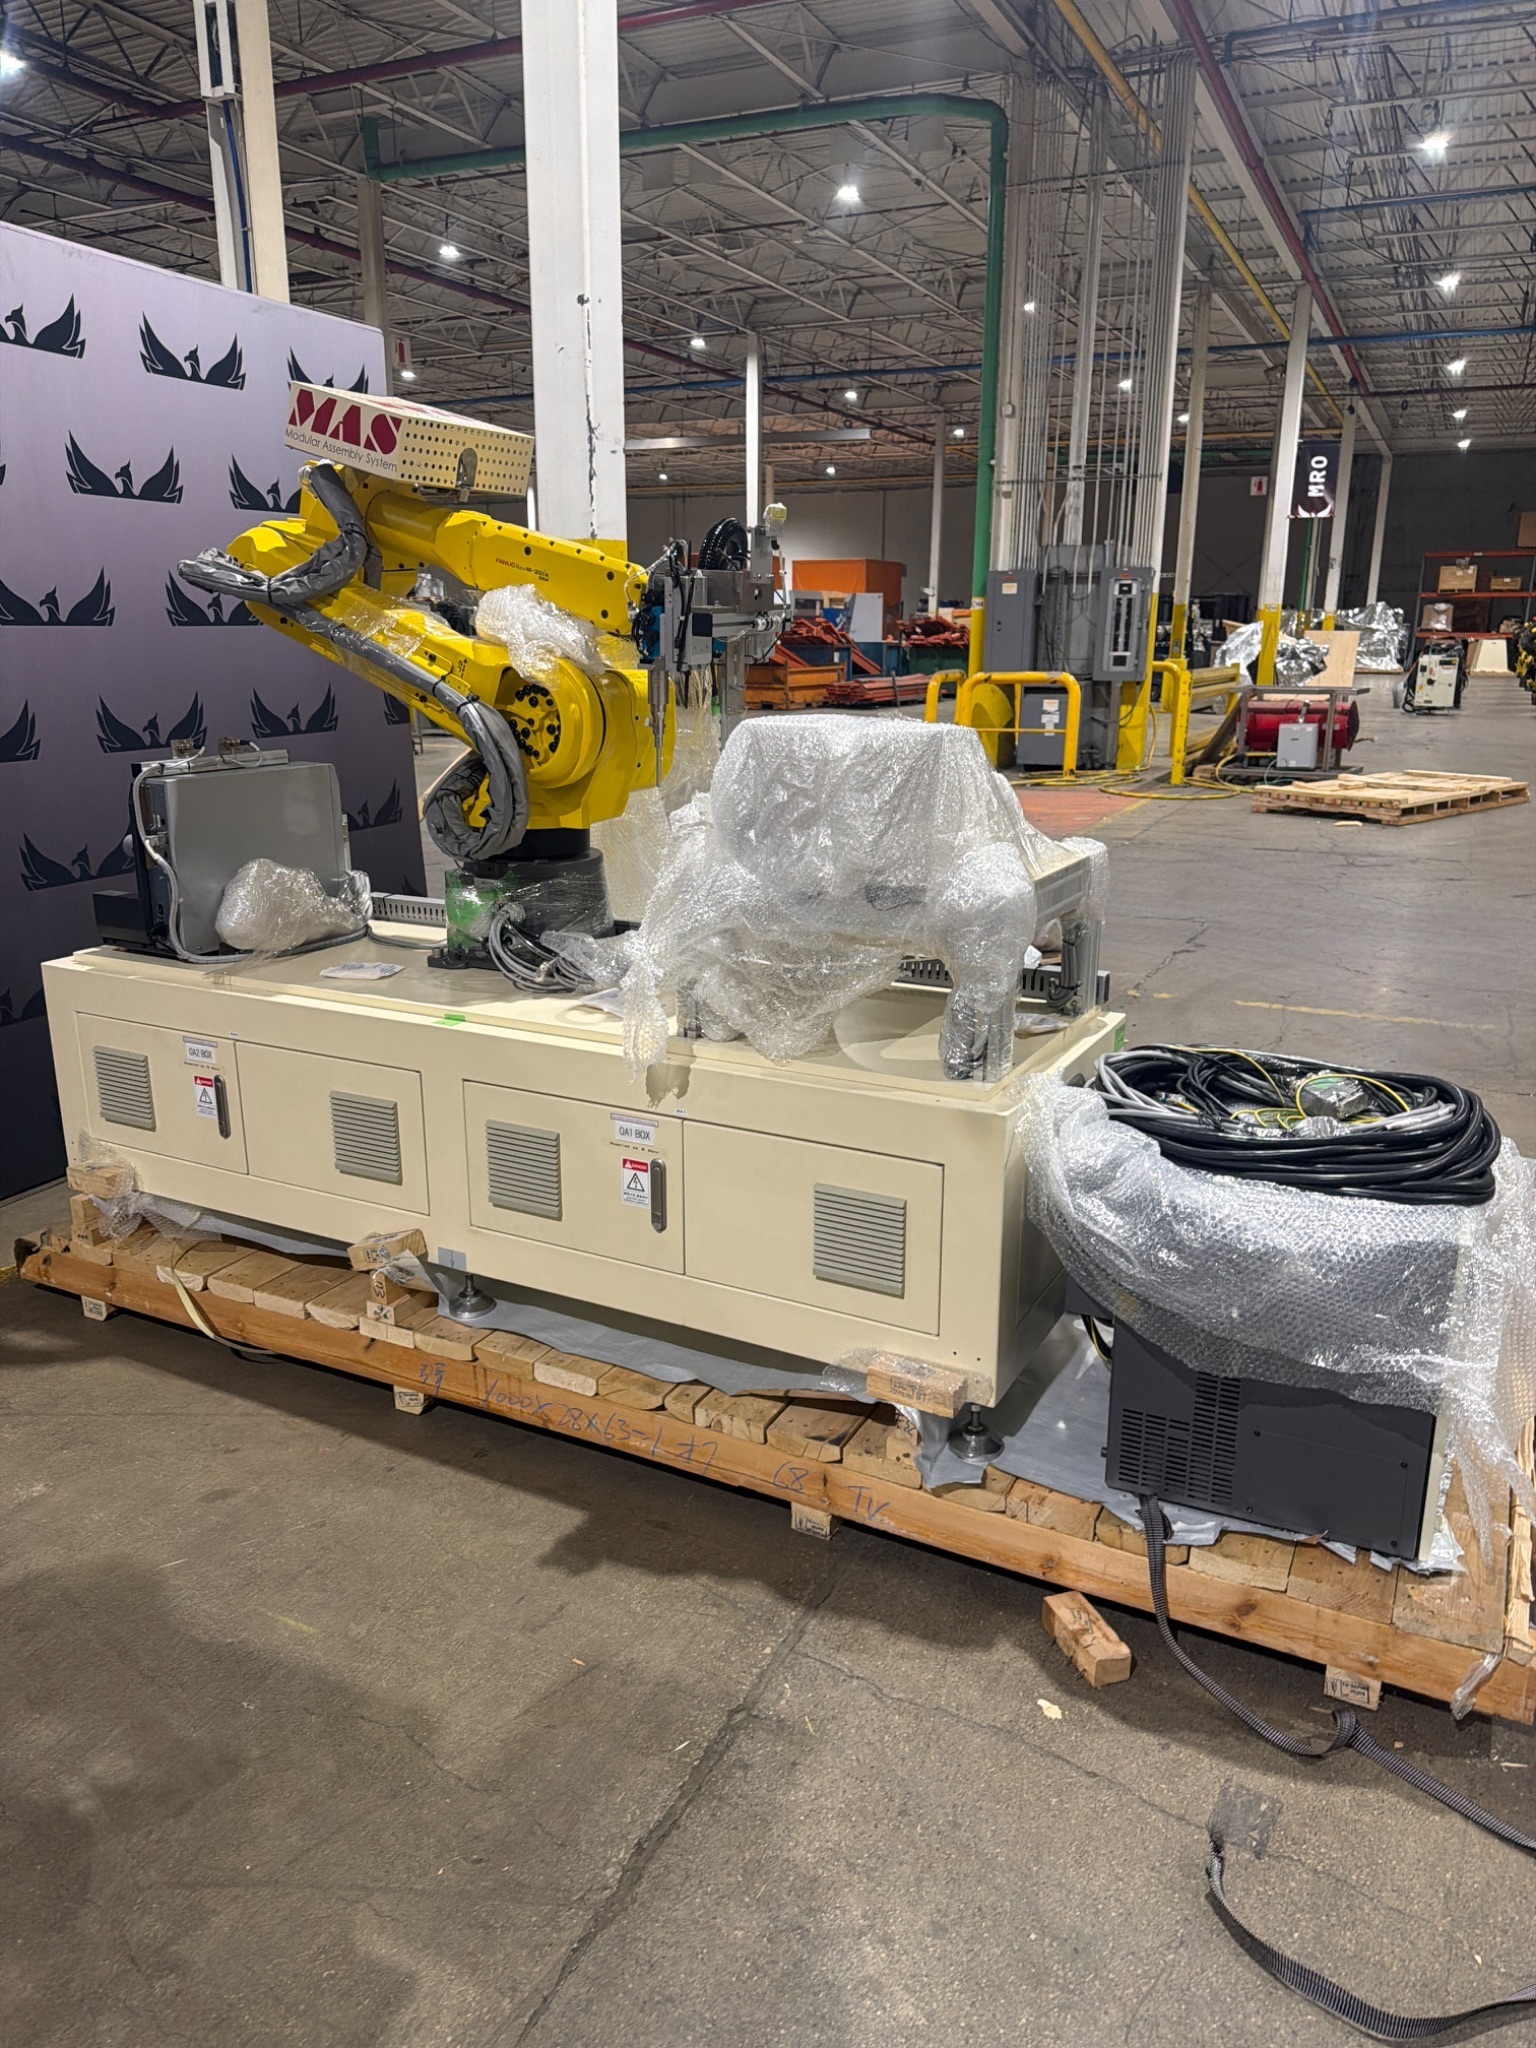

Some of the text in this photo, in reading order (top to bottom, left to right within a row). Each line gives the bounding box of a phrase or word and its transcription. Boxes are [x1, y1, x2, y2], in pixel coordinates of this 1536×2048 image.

[288, 388, 402, 455] MAS
[285, 428, 398, 473] Modular Assembly System
[1307, 455, 1328, 498] MRO
[495, 557, 516, 569] FANUC
[634, 1129, 651, 1141] BOX
